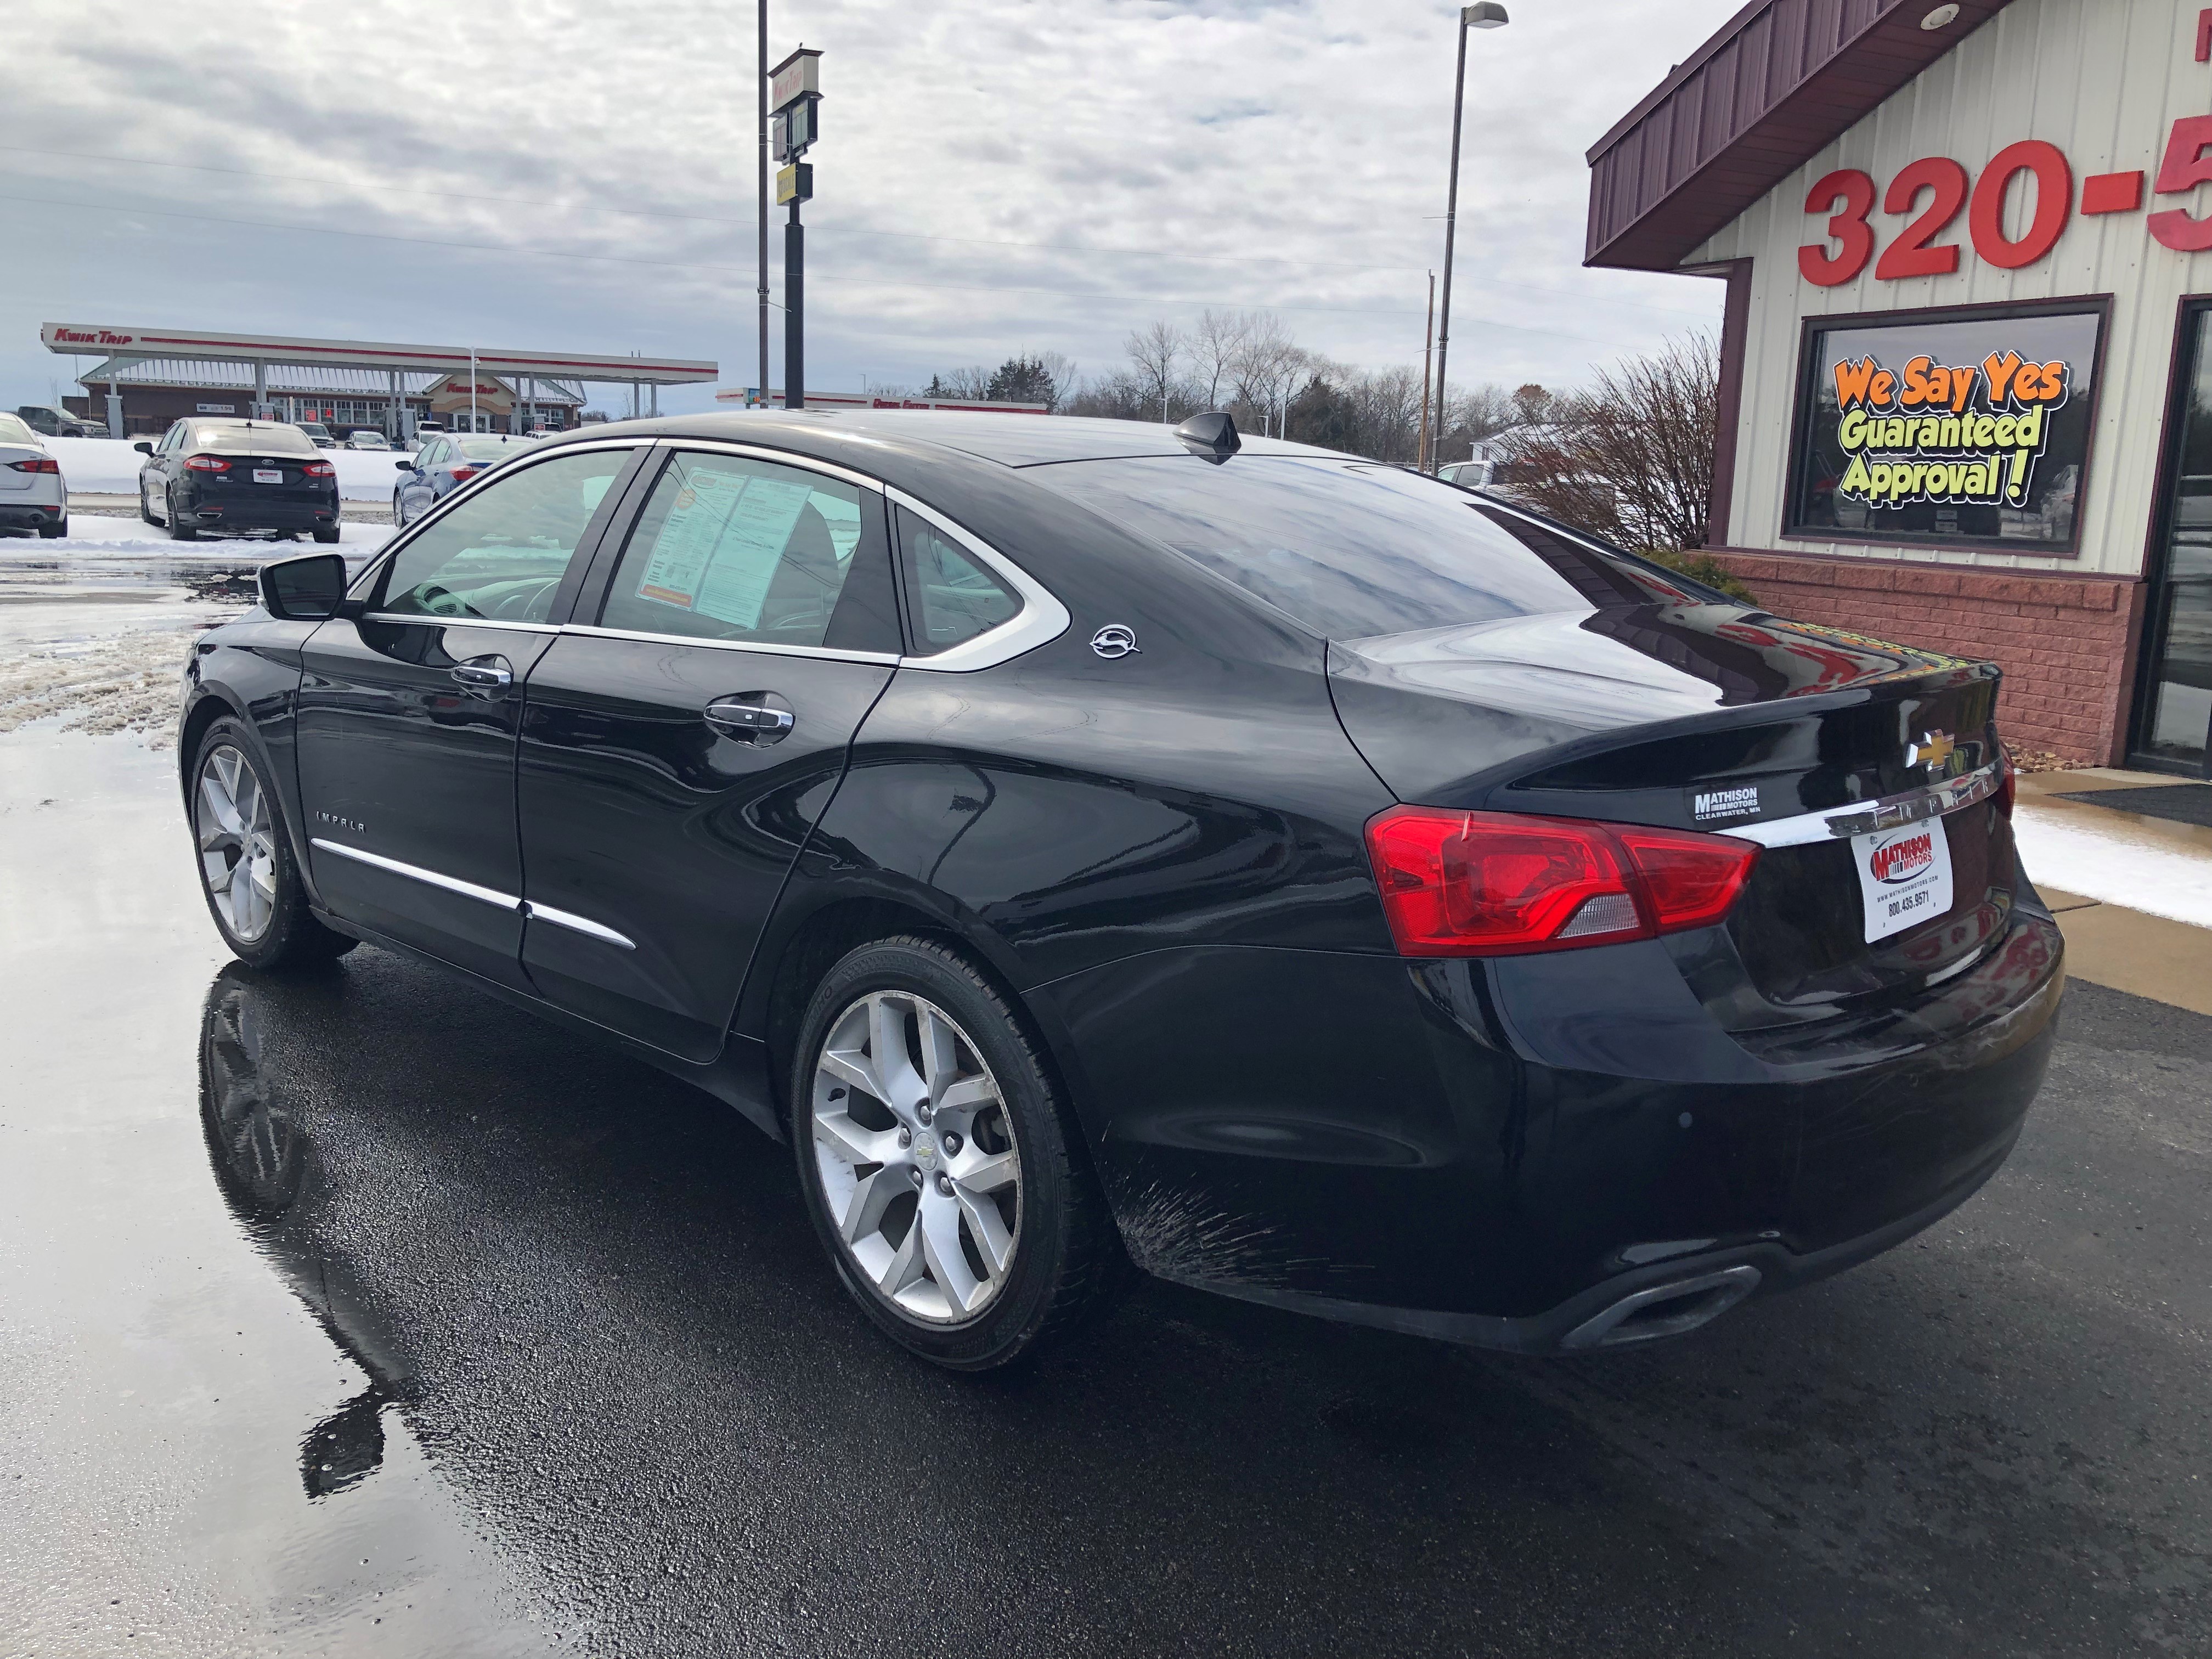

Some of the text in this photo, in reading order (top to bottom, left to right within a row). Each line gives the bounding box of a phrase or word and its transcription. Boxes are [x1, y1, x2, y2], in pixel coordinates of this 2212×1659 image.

[1835, 350, 2064, 413] We Say Yes
[1840, 404, 2044, 450] Guaranteed
[1695, 787, 1758, 814] MATHISON
[1726, 798, 1758, 810] MOTORS
[316, 810, 365, 833] IMPALA
[1695, 809, 1749, 821] CLEARWATER,
[1873, 832, 1933, 882] MATHISON
[1903, 851, 1933, 871] MOTORS
[1888, 889, 1929, 918] 800.435.9571
